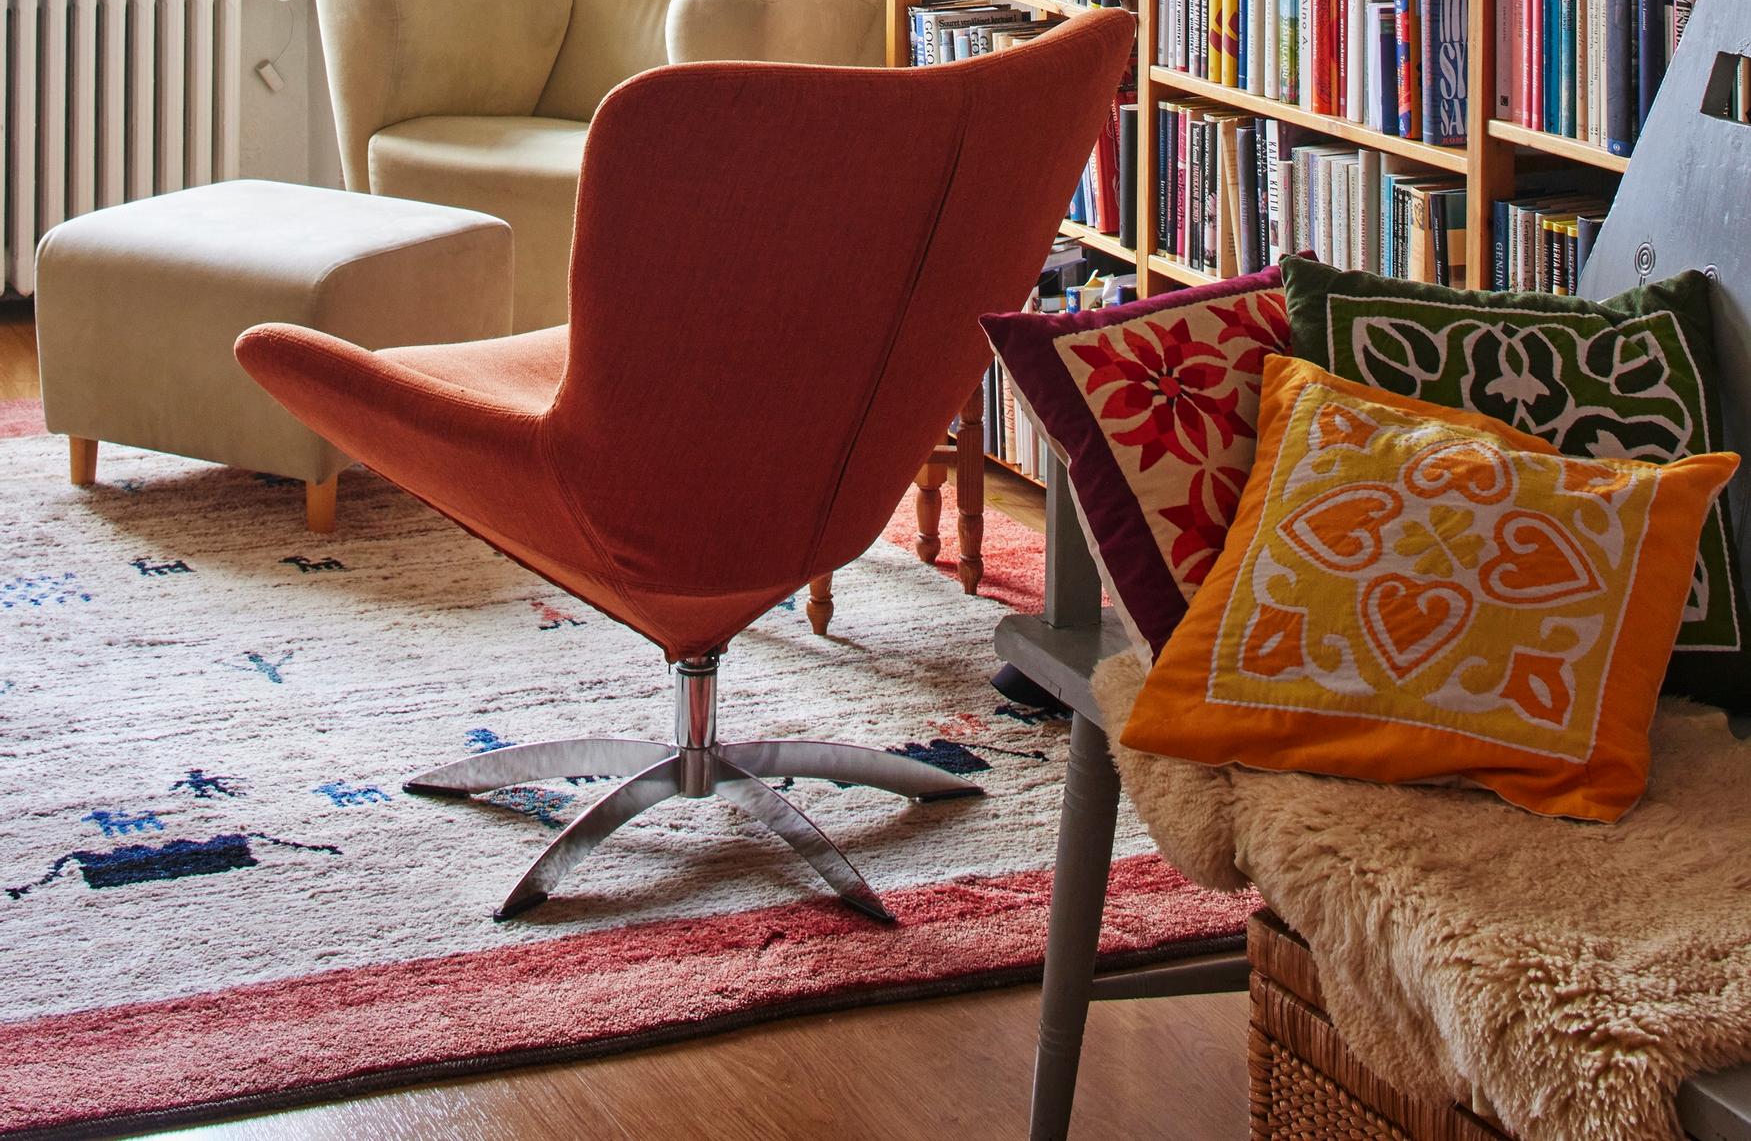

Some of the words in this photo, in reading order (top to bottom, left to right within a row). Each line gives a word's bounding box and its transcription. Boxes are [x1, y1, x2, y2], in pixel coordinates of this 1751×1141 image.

[939, 19, 961, 28] Suuret
[1395, 8, 1403, 46] Evaristo
[1268, 142, 1277, 174] KATJA
[1269, 181, 1278, 212] KETTU
[1495, 242, 1503, 287] GENJIN
